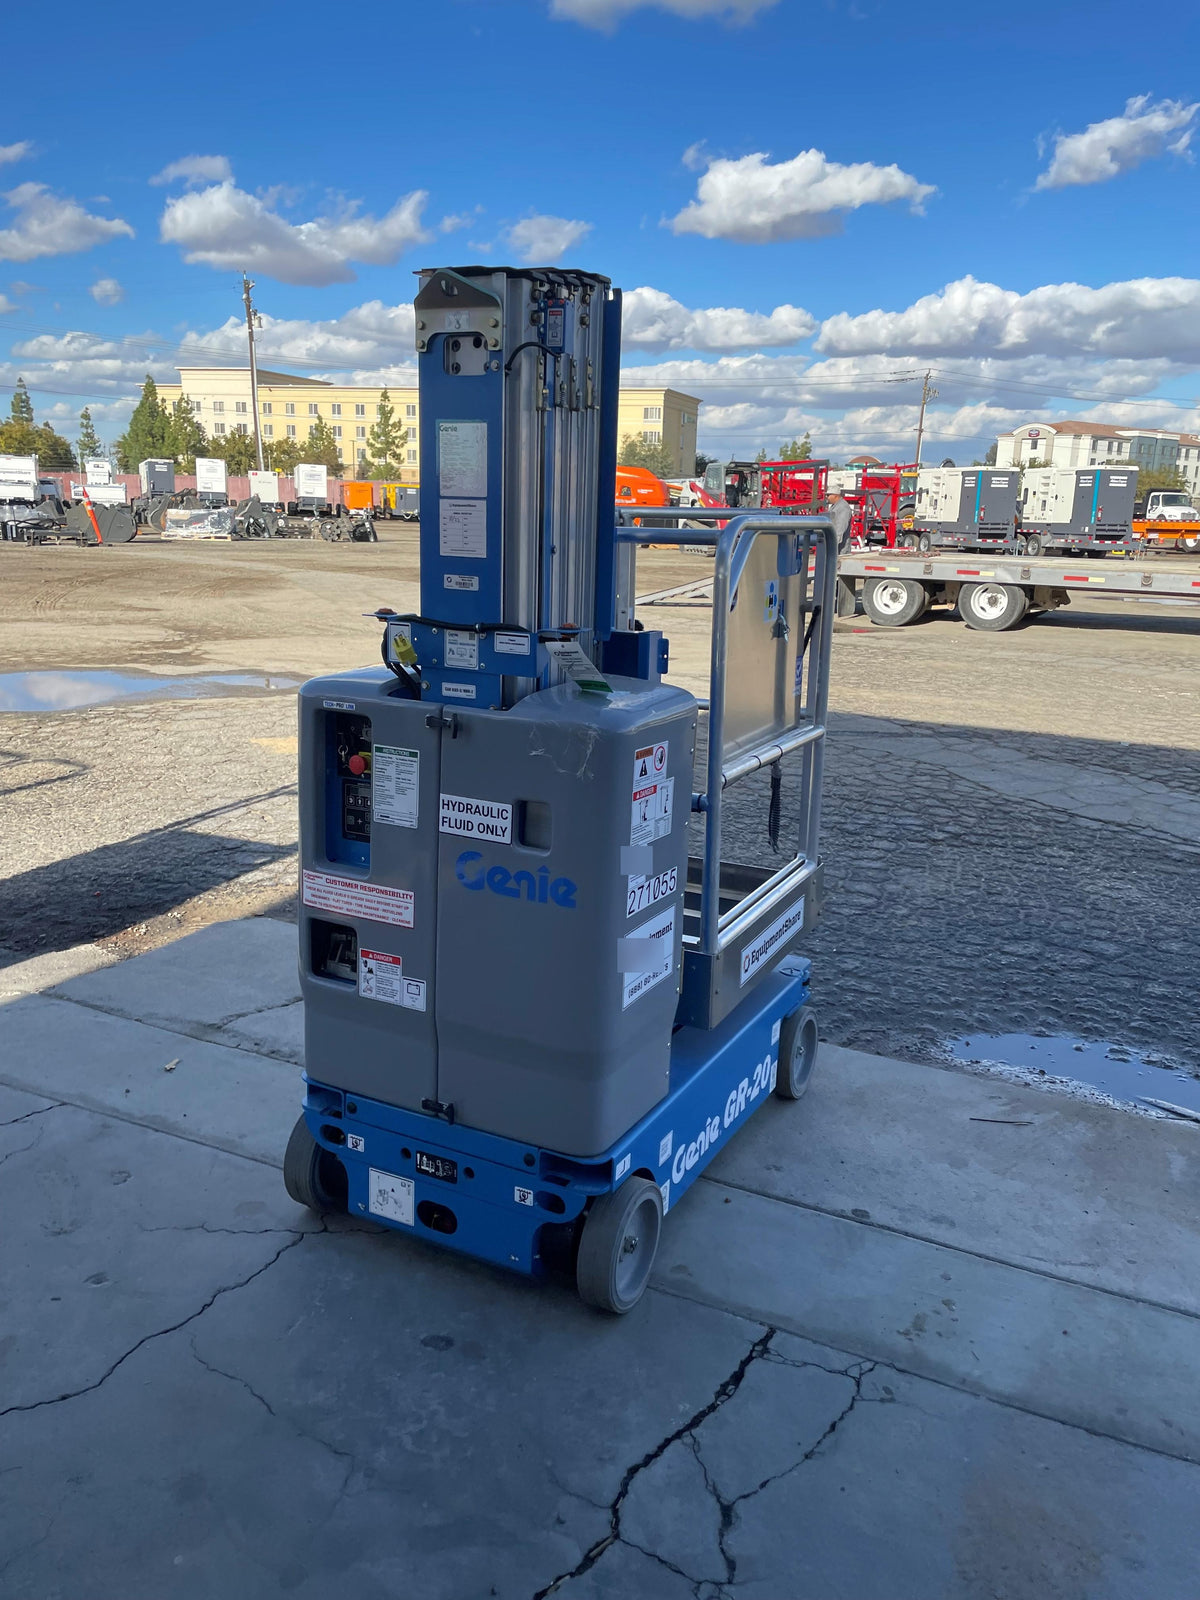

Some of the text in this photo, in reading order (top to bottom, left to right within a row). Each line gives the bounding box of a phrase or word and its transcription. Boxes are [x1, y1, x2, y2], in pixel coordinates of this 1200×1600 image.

[441, 799, 509, 821] HYDRAULIC
[441, 816, 508, 838] FLUID ONLY
[325, 877, 413, 900] CUSTOMER RESPONSIBILITY
[455, 850, 578, 909] Genie
[627, 868, 676, 915] 271055
[751, 910, 801, 965] EquipmentShare
[373, 953, 393, 963] DANGER
[672, 1053, 772, 1184] Genie GR-20
